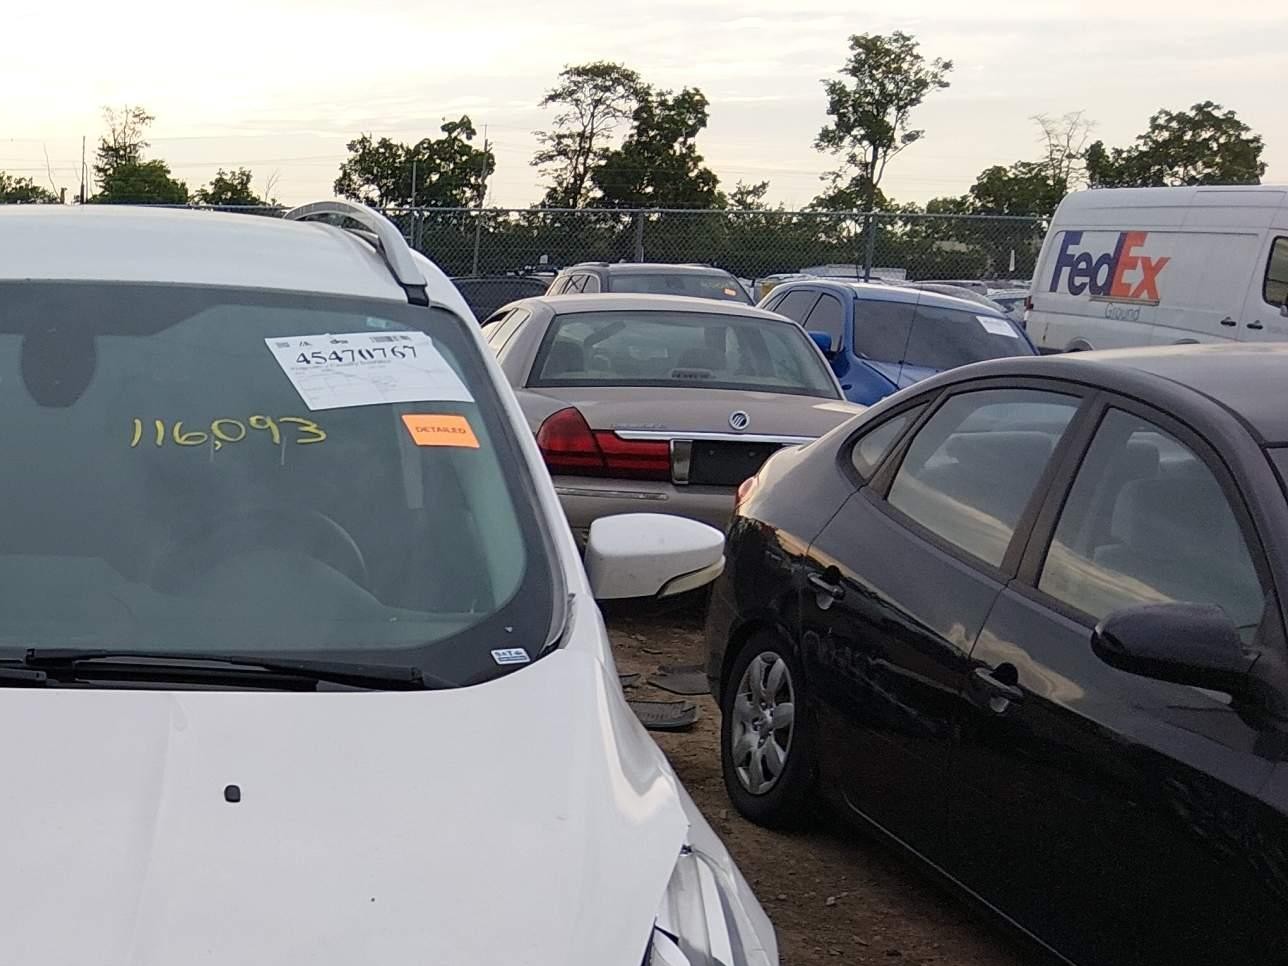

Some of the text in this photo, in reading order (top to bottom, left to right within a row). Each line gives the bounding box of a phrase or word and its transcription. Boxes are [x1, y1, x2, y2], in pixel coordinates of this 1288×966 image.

[1049, 230, 1171, 299] FedEx
[1105, 303, 1142, 321] Ground
[131, 415, 327, 450] 116,093
[415, 426, 466, 434] DETAILED
